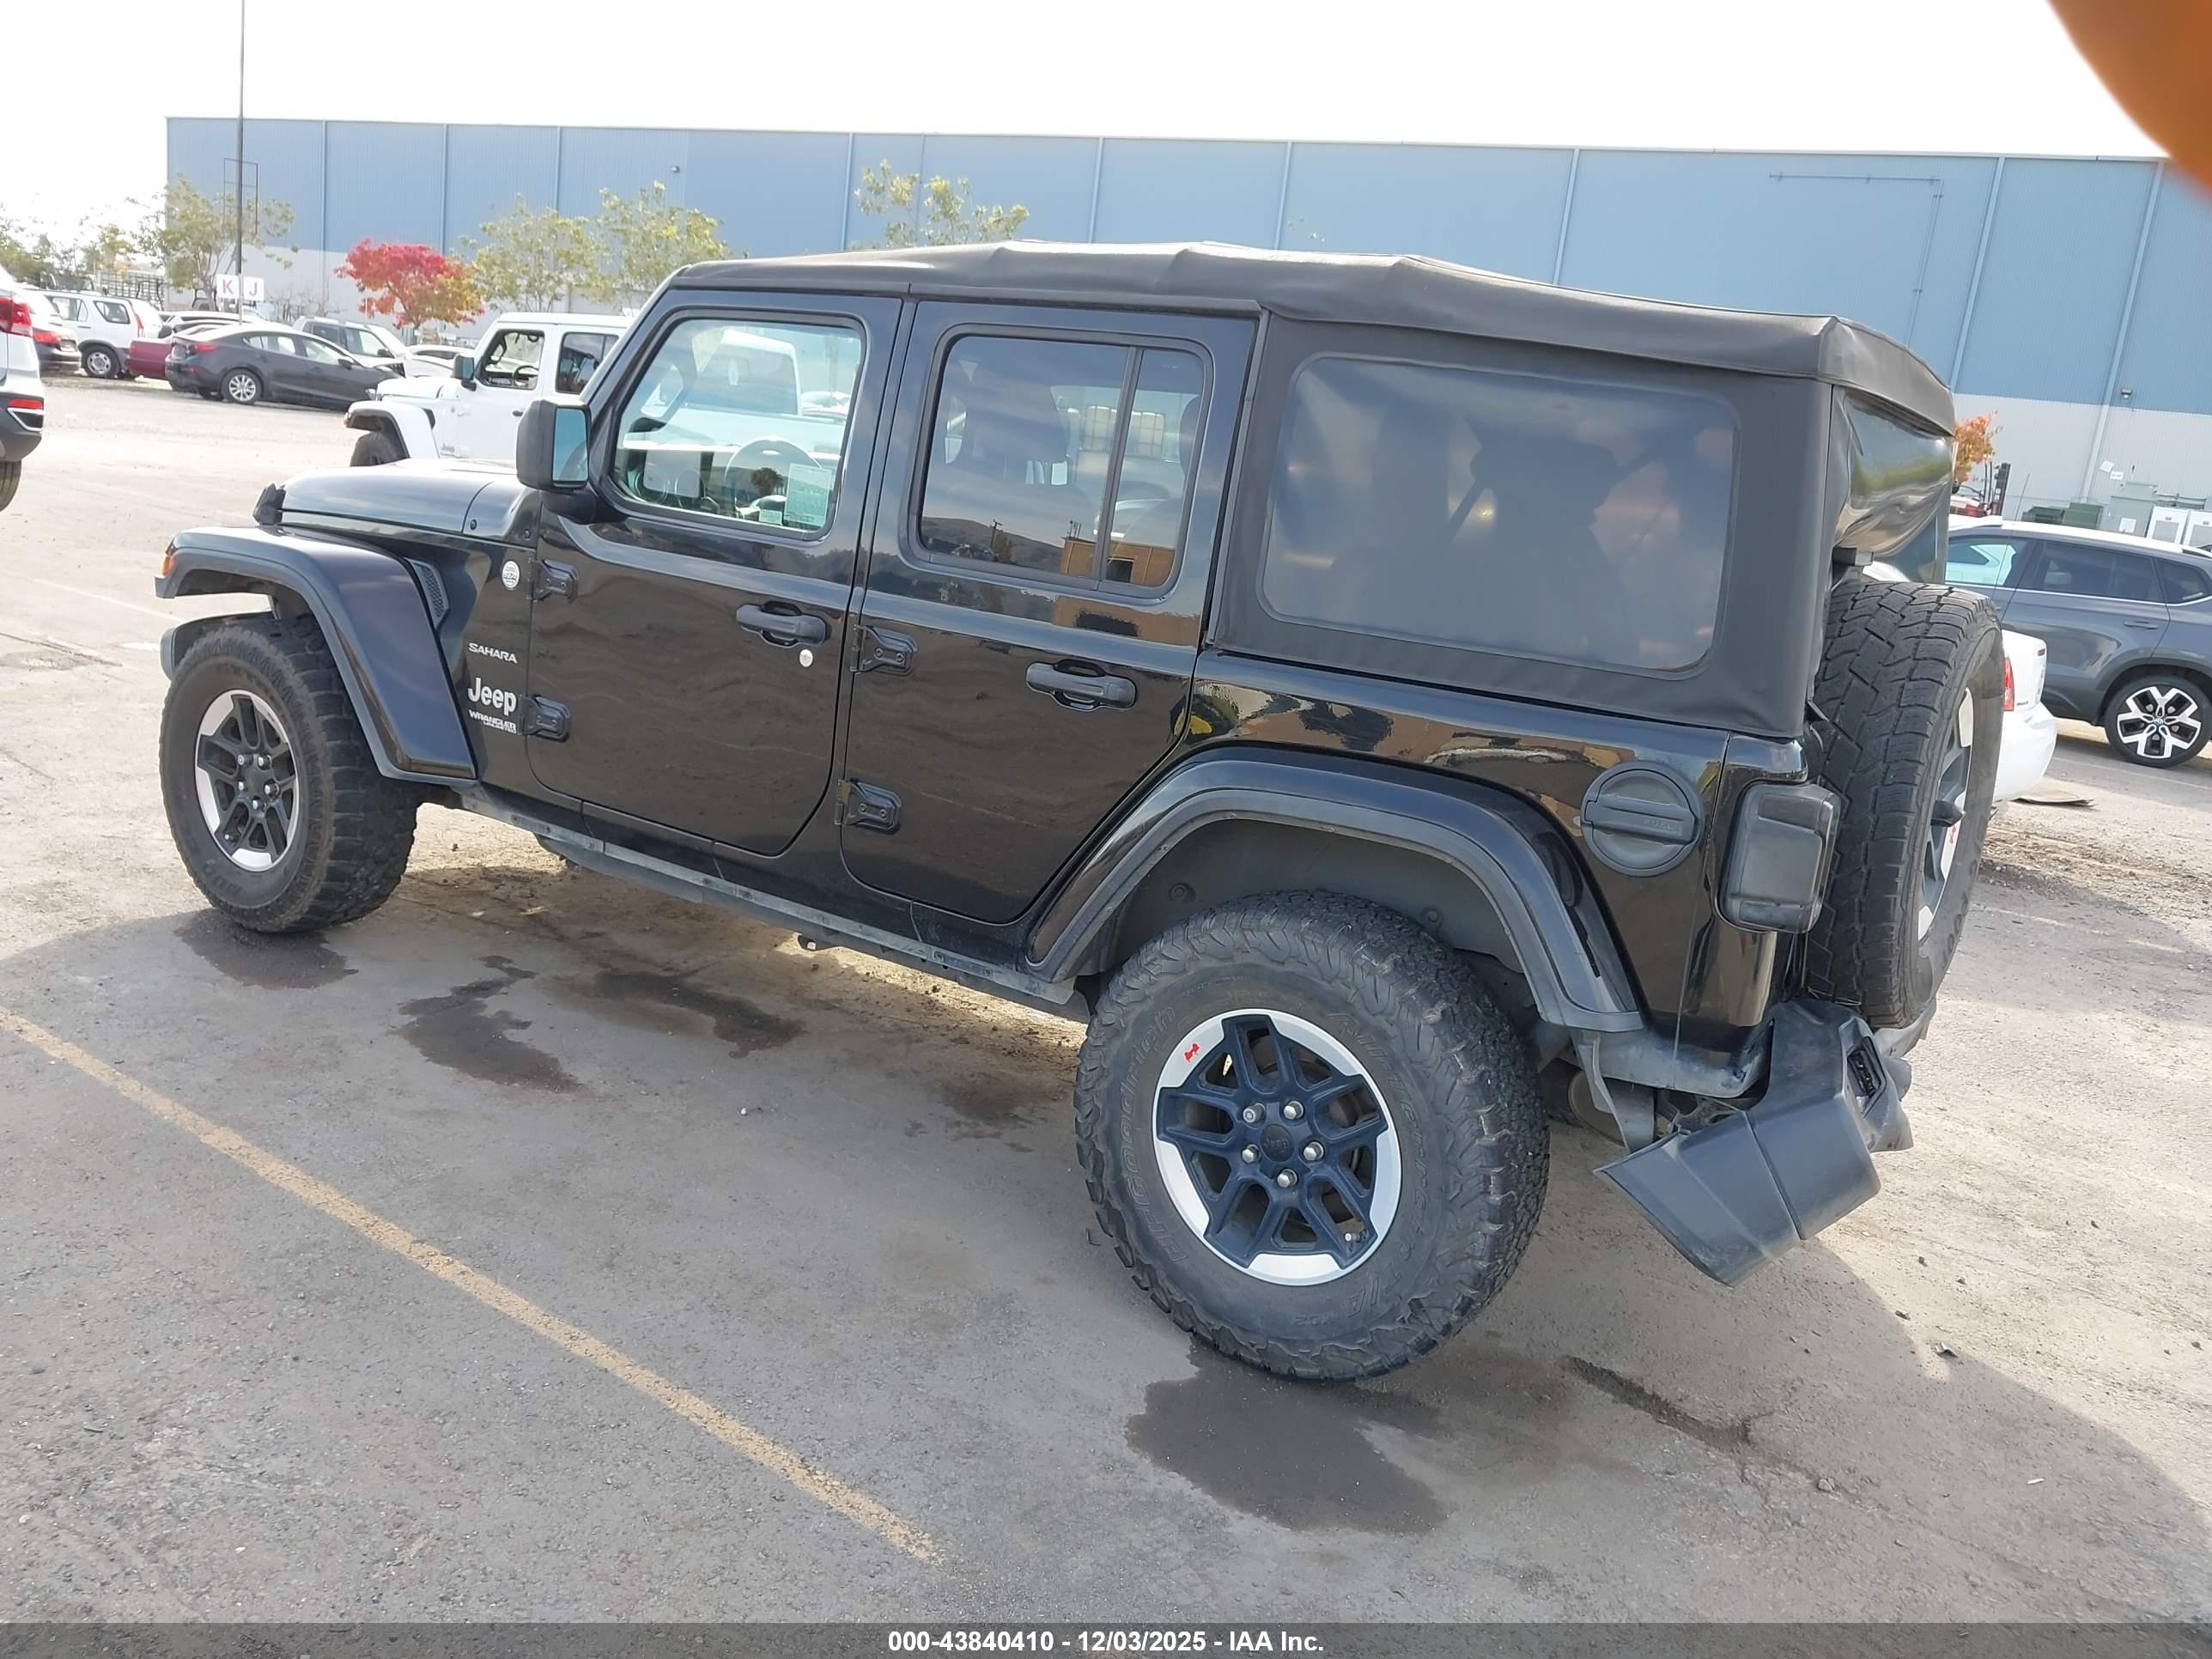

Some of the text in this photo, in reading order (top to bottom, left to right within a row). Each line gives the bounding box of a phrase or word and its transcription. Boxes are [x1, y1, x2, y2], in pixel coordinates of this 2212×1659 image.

[222, 279, 234, 295] K
[249, 282, 258, 296] J
[468, 642, 518, 664] SAHARA
[467, 677, 517, 716] Jeep
[468, 708, 517, 731] WRANGLER
[1120, 1006, 1188, 1264] BFGoodrich
